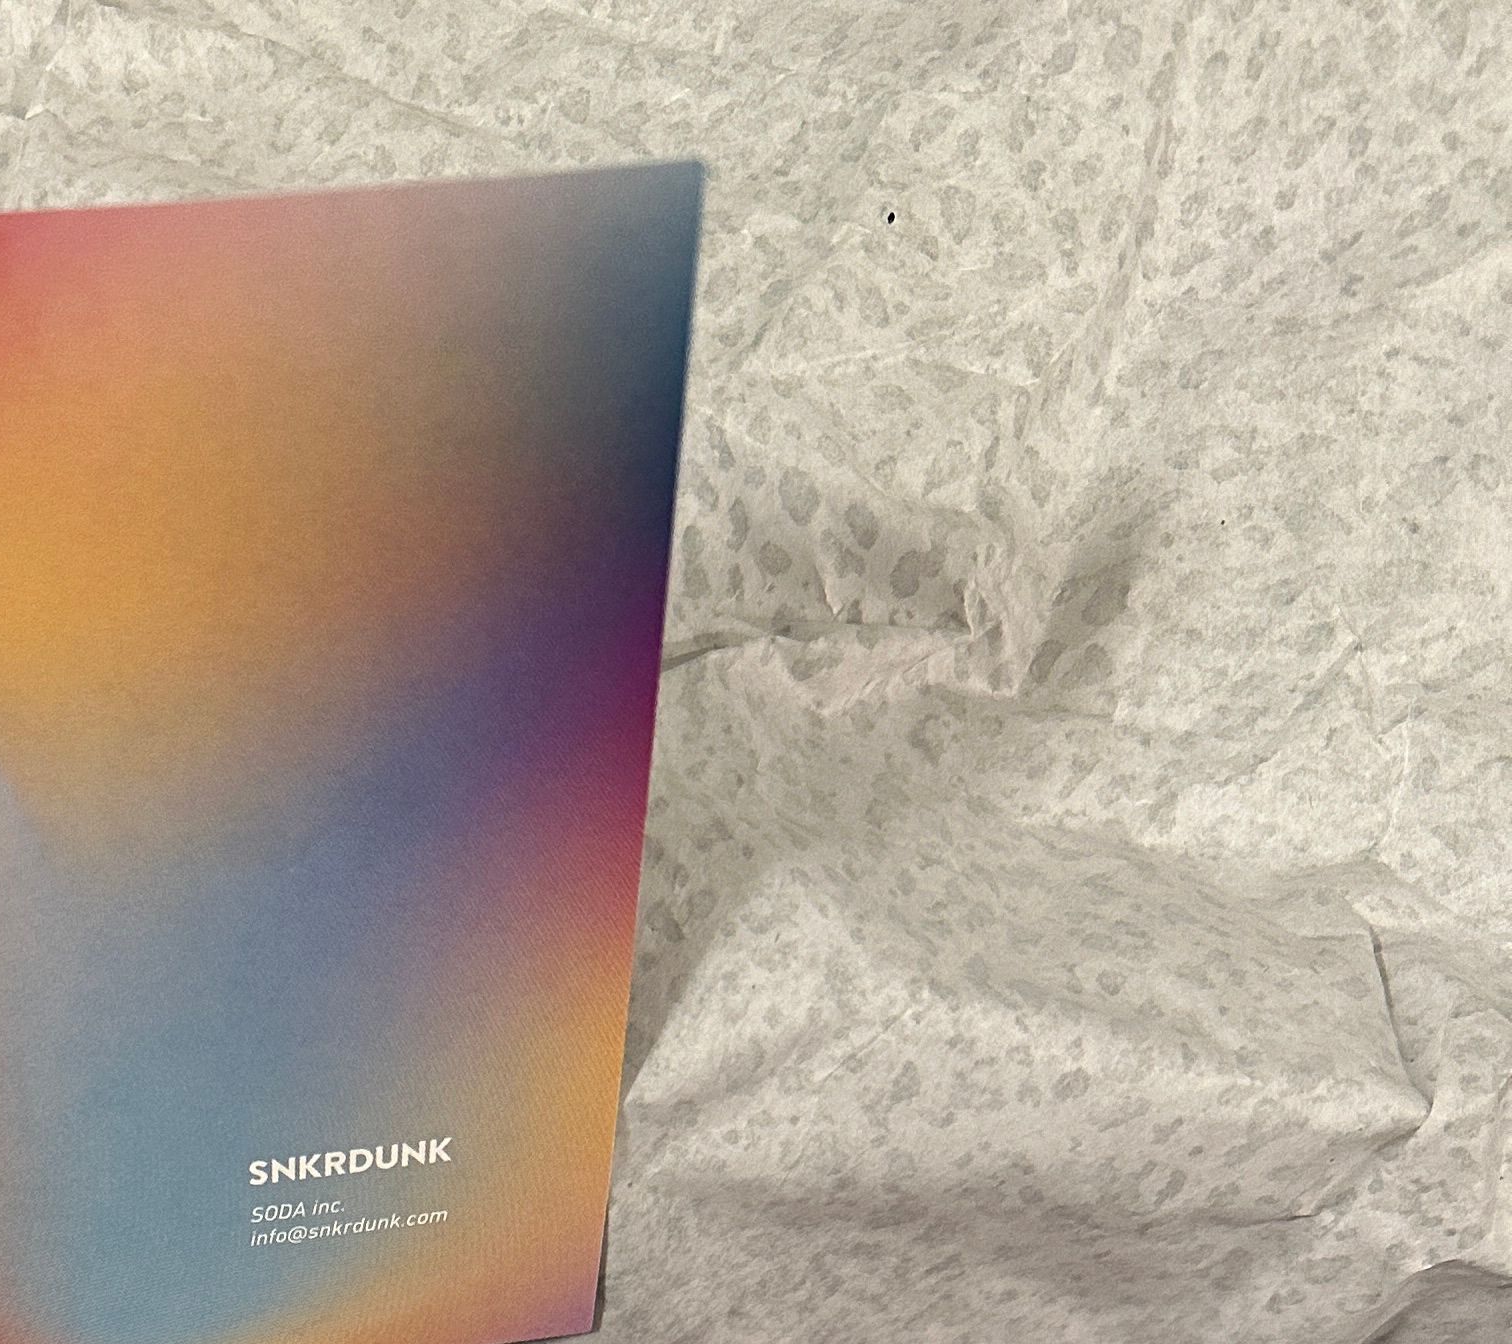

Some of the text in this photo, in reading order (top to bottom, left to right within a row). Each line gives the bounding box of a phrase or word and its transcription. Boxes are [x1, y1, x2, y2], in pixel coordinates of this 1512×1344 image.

[248, 1136, 453, 1186] SNKRDUNK
[250, 1199, 345, 1224] SODA inc.
[250, 1208, 449, 1247] info@snkrdunk.com
